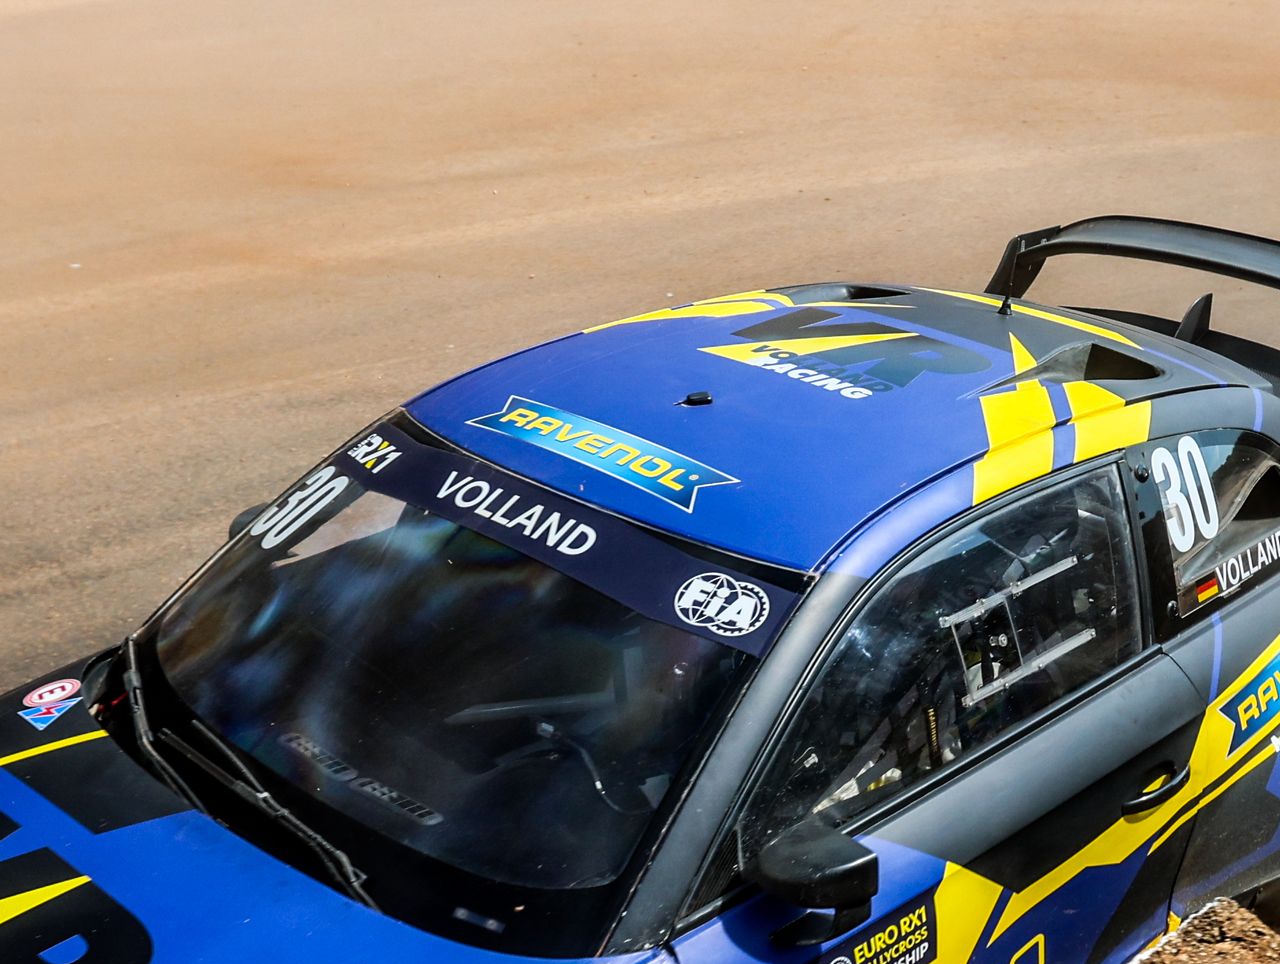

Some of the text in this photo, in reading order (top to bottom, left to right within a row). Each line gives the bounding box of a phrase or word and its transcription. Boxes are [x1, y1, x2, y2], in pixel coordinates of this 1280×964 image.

[746, 355, 874, 400] RACING
[751, 344, 894, 394] VOLLAND
[499, 407, 687, 491] RAVENOL
[250, 465, 350, 550] 30
[436, 470, 597, 558] VOLLAND
[1150, 433, 1221, 553] 30
[853, 905, 928, 964] EURO RX1
